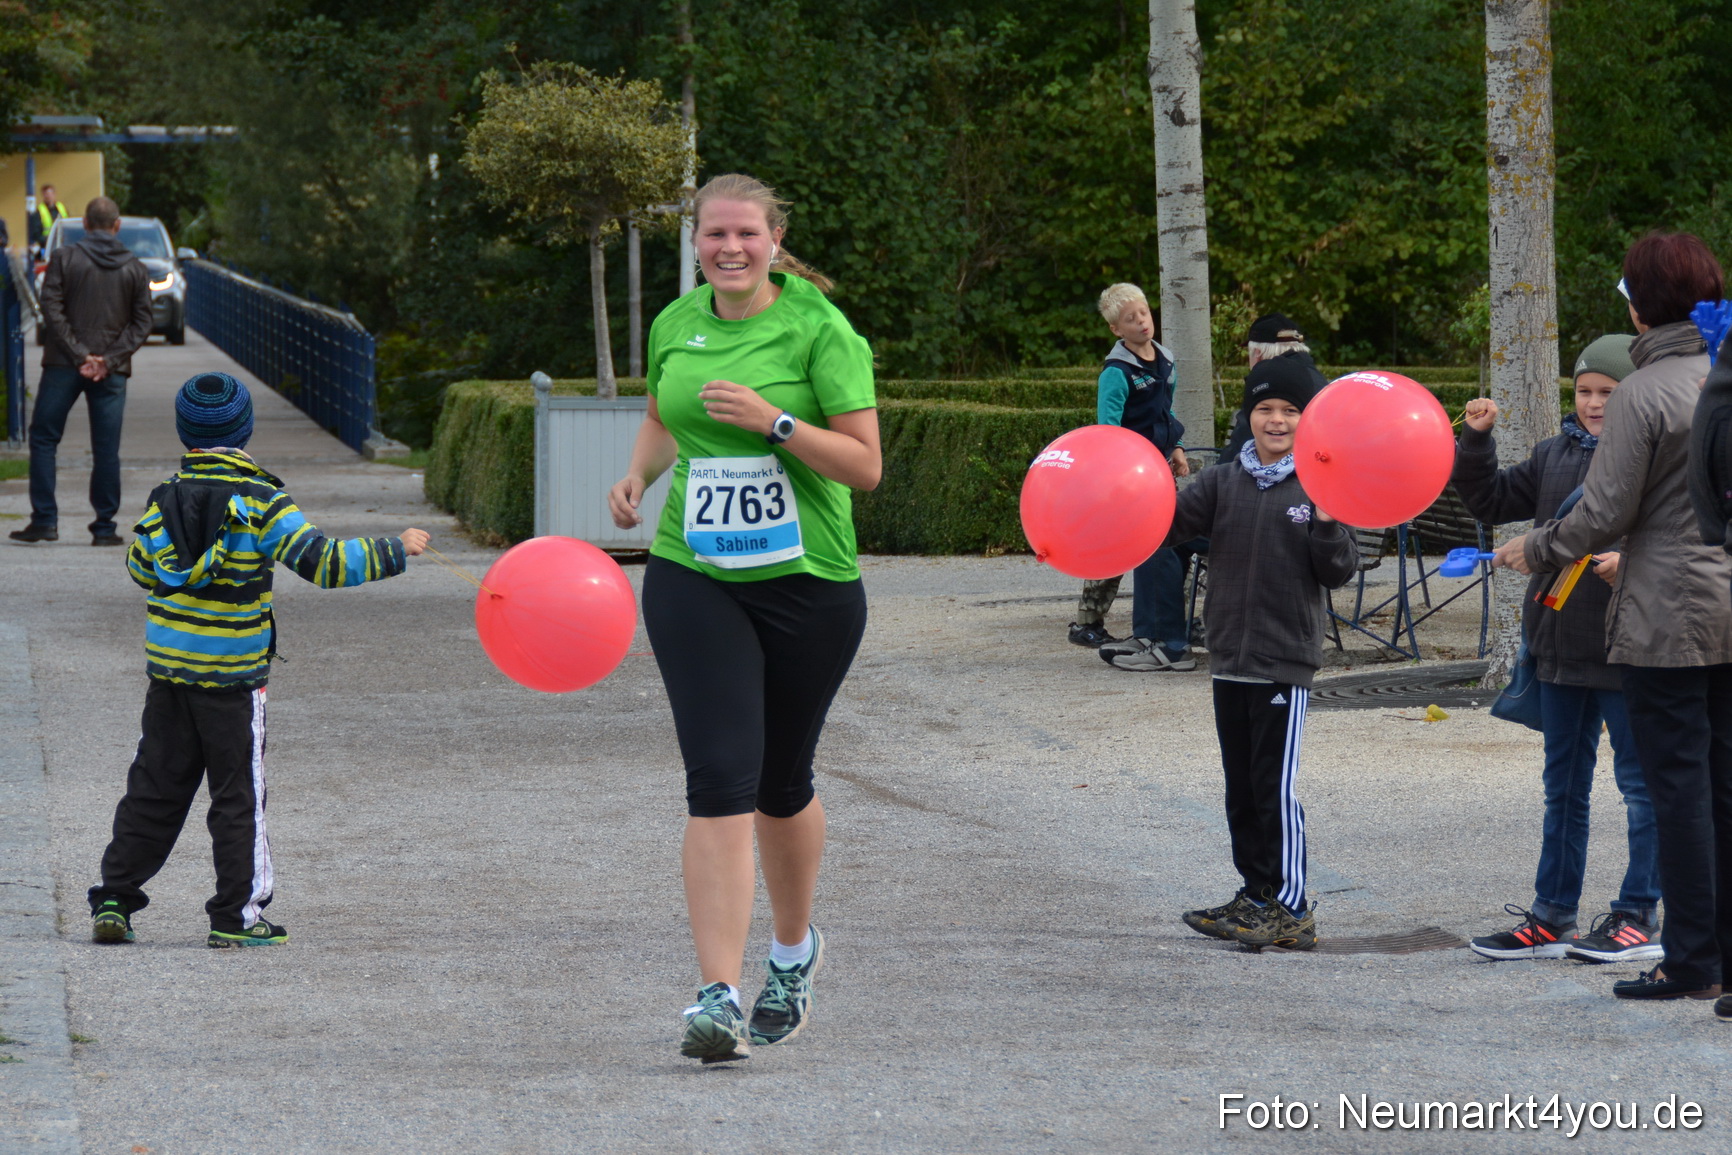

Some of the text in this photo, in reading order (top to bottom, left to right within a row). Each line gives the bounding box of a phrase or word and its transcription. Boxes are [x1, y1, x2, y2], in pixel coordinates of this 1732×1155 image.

[1041, 461, 1071, 470] energie
[690, 467, 773, 479] PARTL Neumarkt
[695, 481, 786, 525] 2763
[715, 535, 769, 552] Sabine
